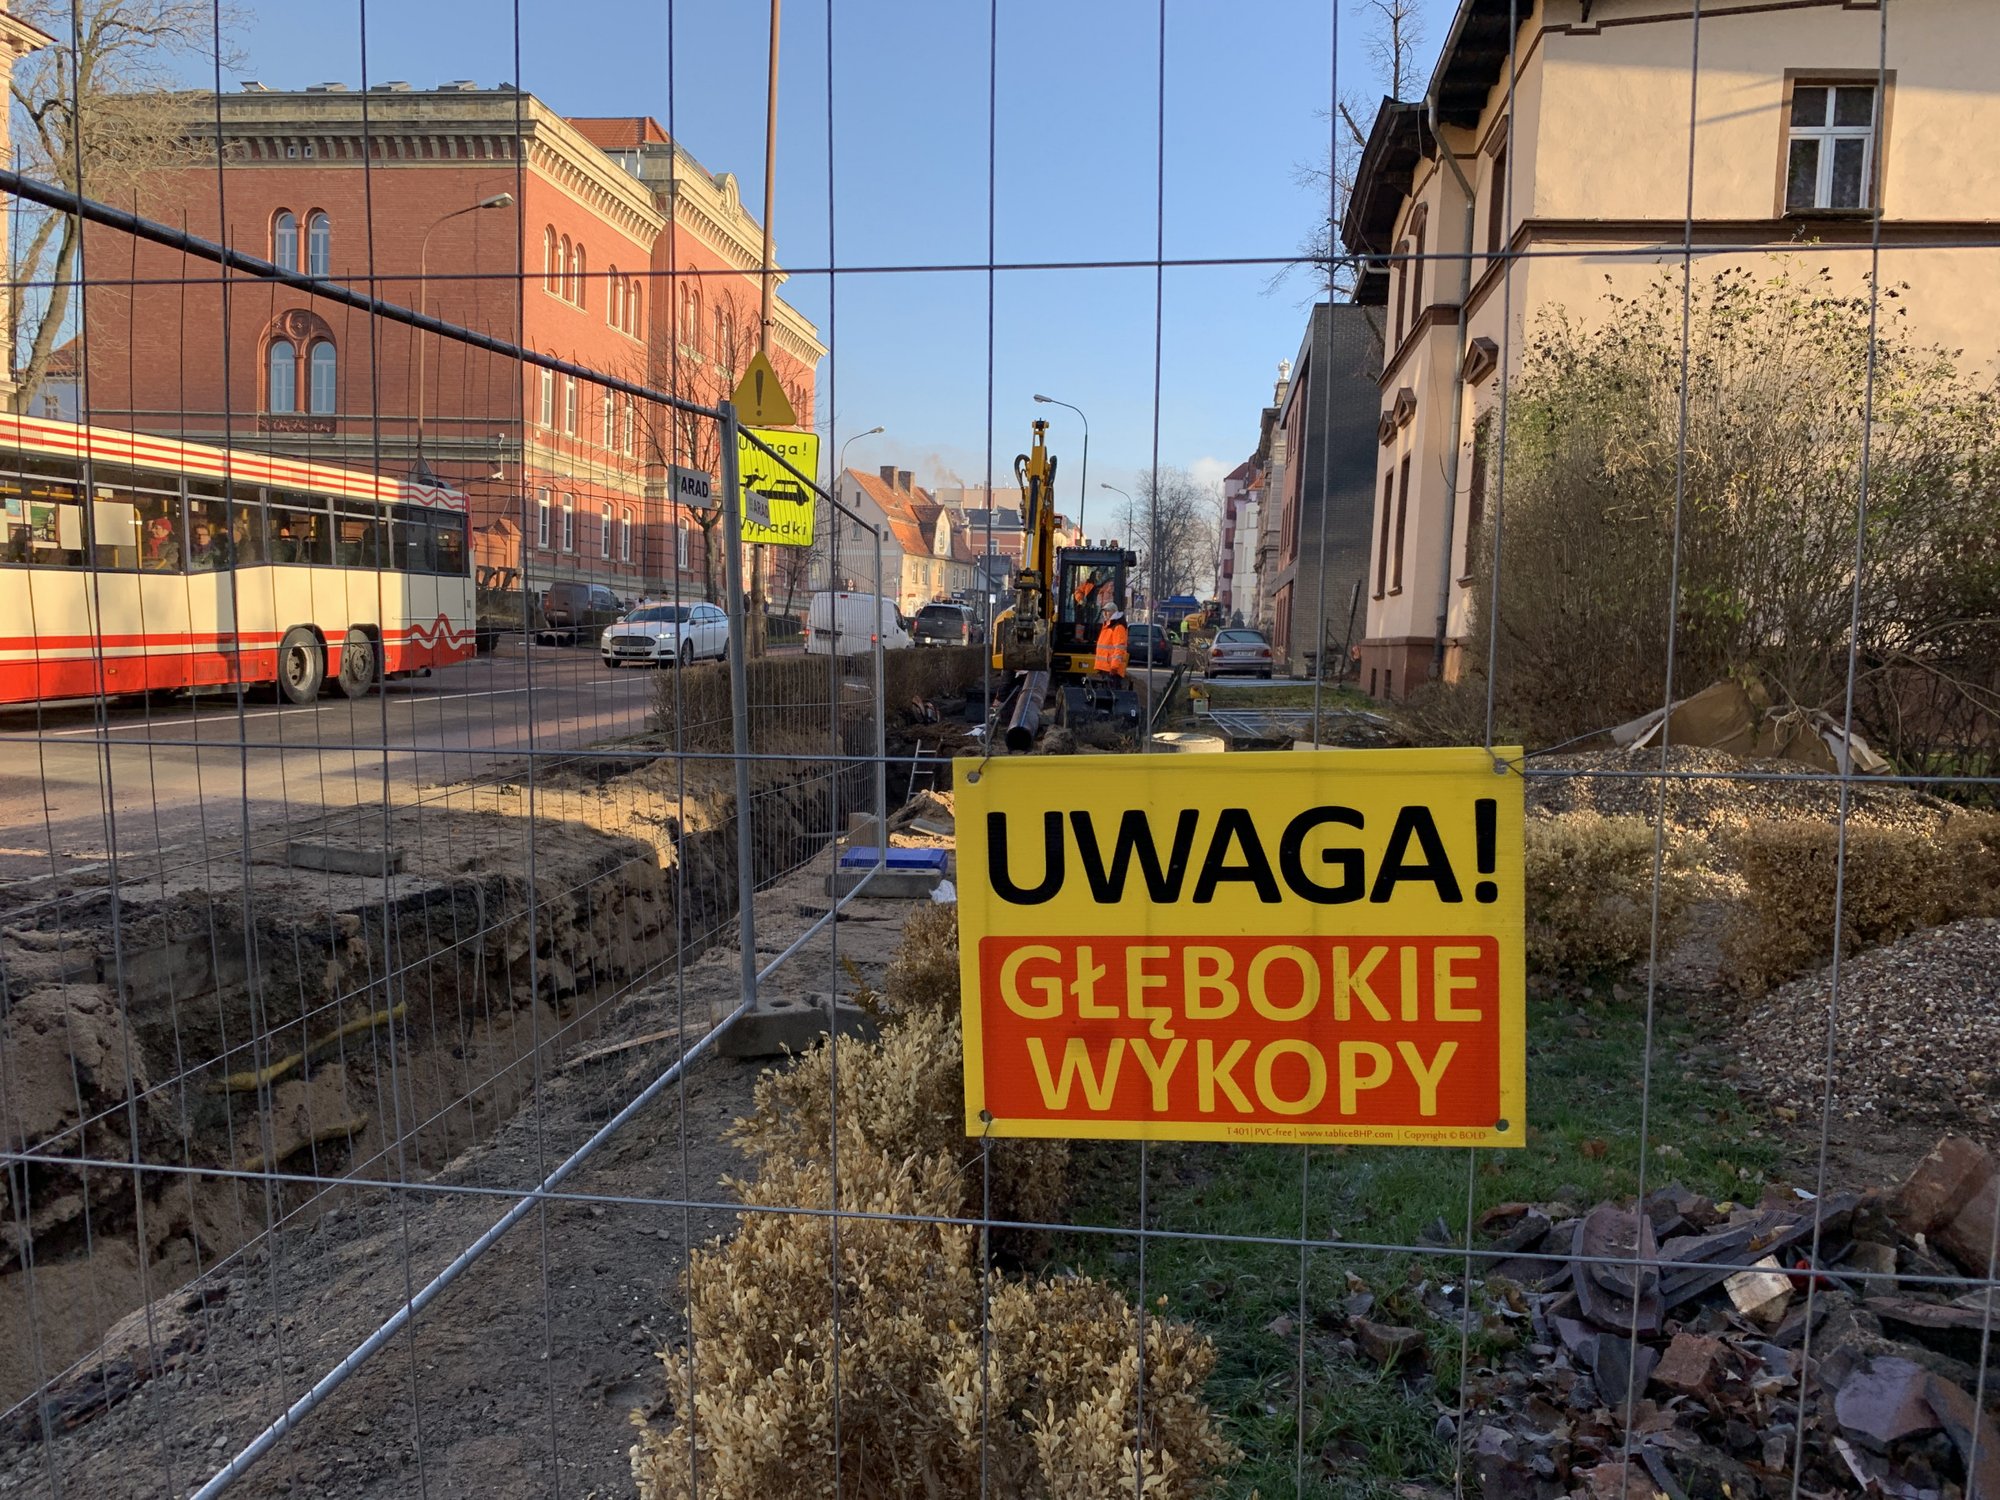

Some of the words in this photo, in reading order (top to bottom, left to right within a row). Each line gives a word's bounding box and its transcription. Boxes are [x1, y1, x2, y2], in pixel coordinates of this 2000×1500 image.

[741, 518, 807, 536] ypadki
[986, 798, 1498, 905] UWAGA!
[999, 945, 1483, 1039] GŁĘBOKIE
[1026, 1037, 1459, 1116] WYKOPY
[1255, 1127, 1292, 1136] PVC-free
[1299, 1128, 1393, 1139] www.tabliceBHP.com
[1404, 1130, 1447, 1142] Copyright
[1459, 1131, 1486, 1140] BOLD
